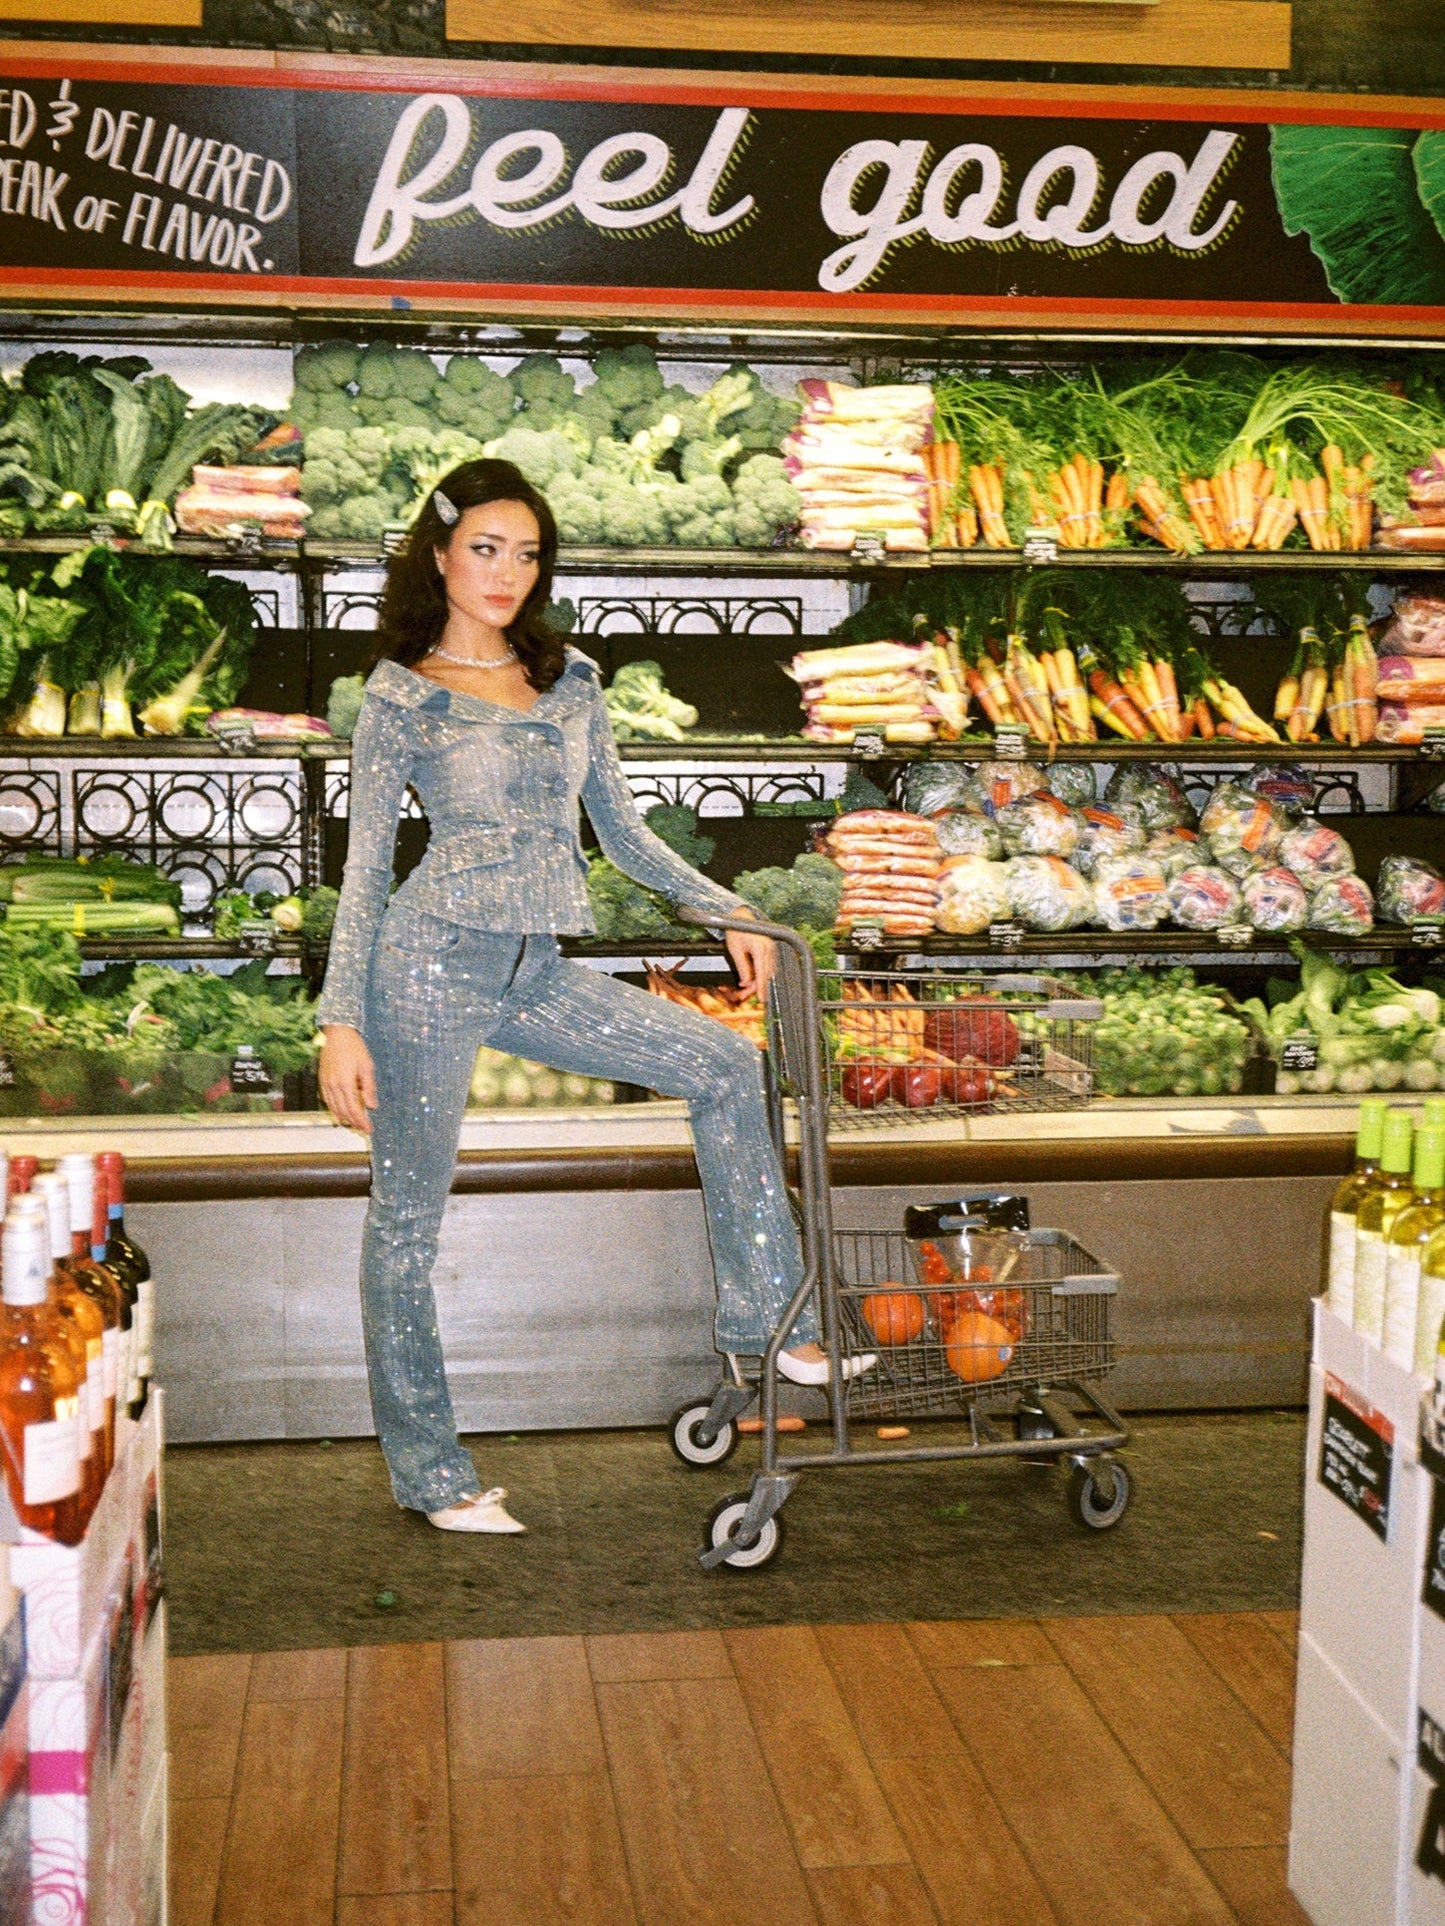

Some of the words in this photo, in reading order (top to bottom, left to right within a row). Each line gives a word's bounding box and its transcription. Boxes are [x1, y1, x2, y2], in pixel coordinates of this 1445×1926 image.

[46, 78, 81, 152] &
[85, 107, 292, 223] DELIVERED
[353, 93, 757, 268] feel
[817, 129, 1239, 293] good
[73, 195, 122, 234] OF
[122, 191, 275, 272] FLAVOR.
